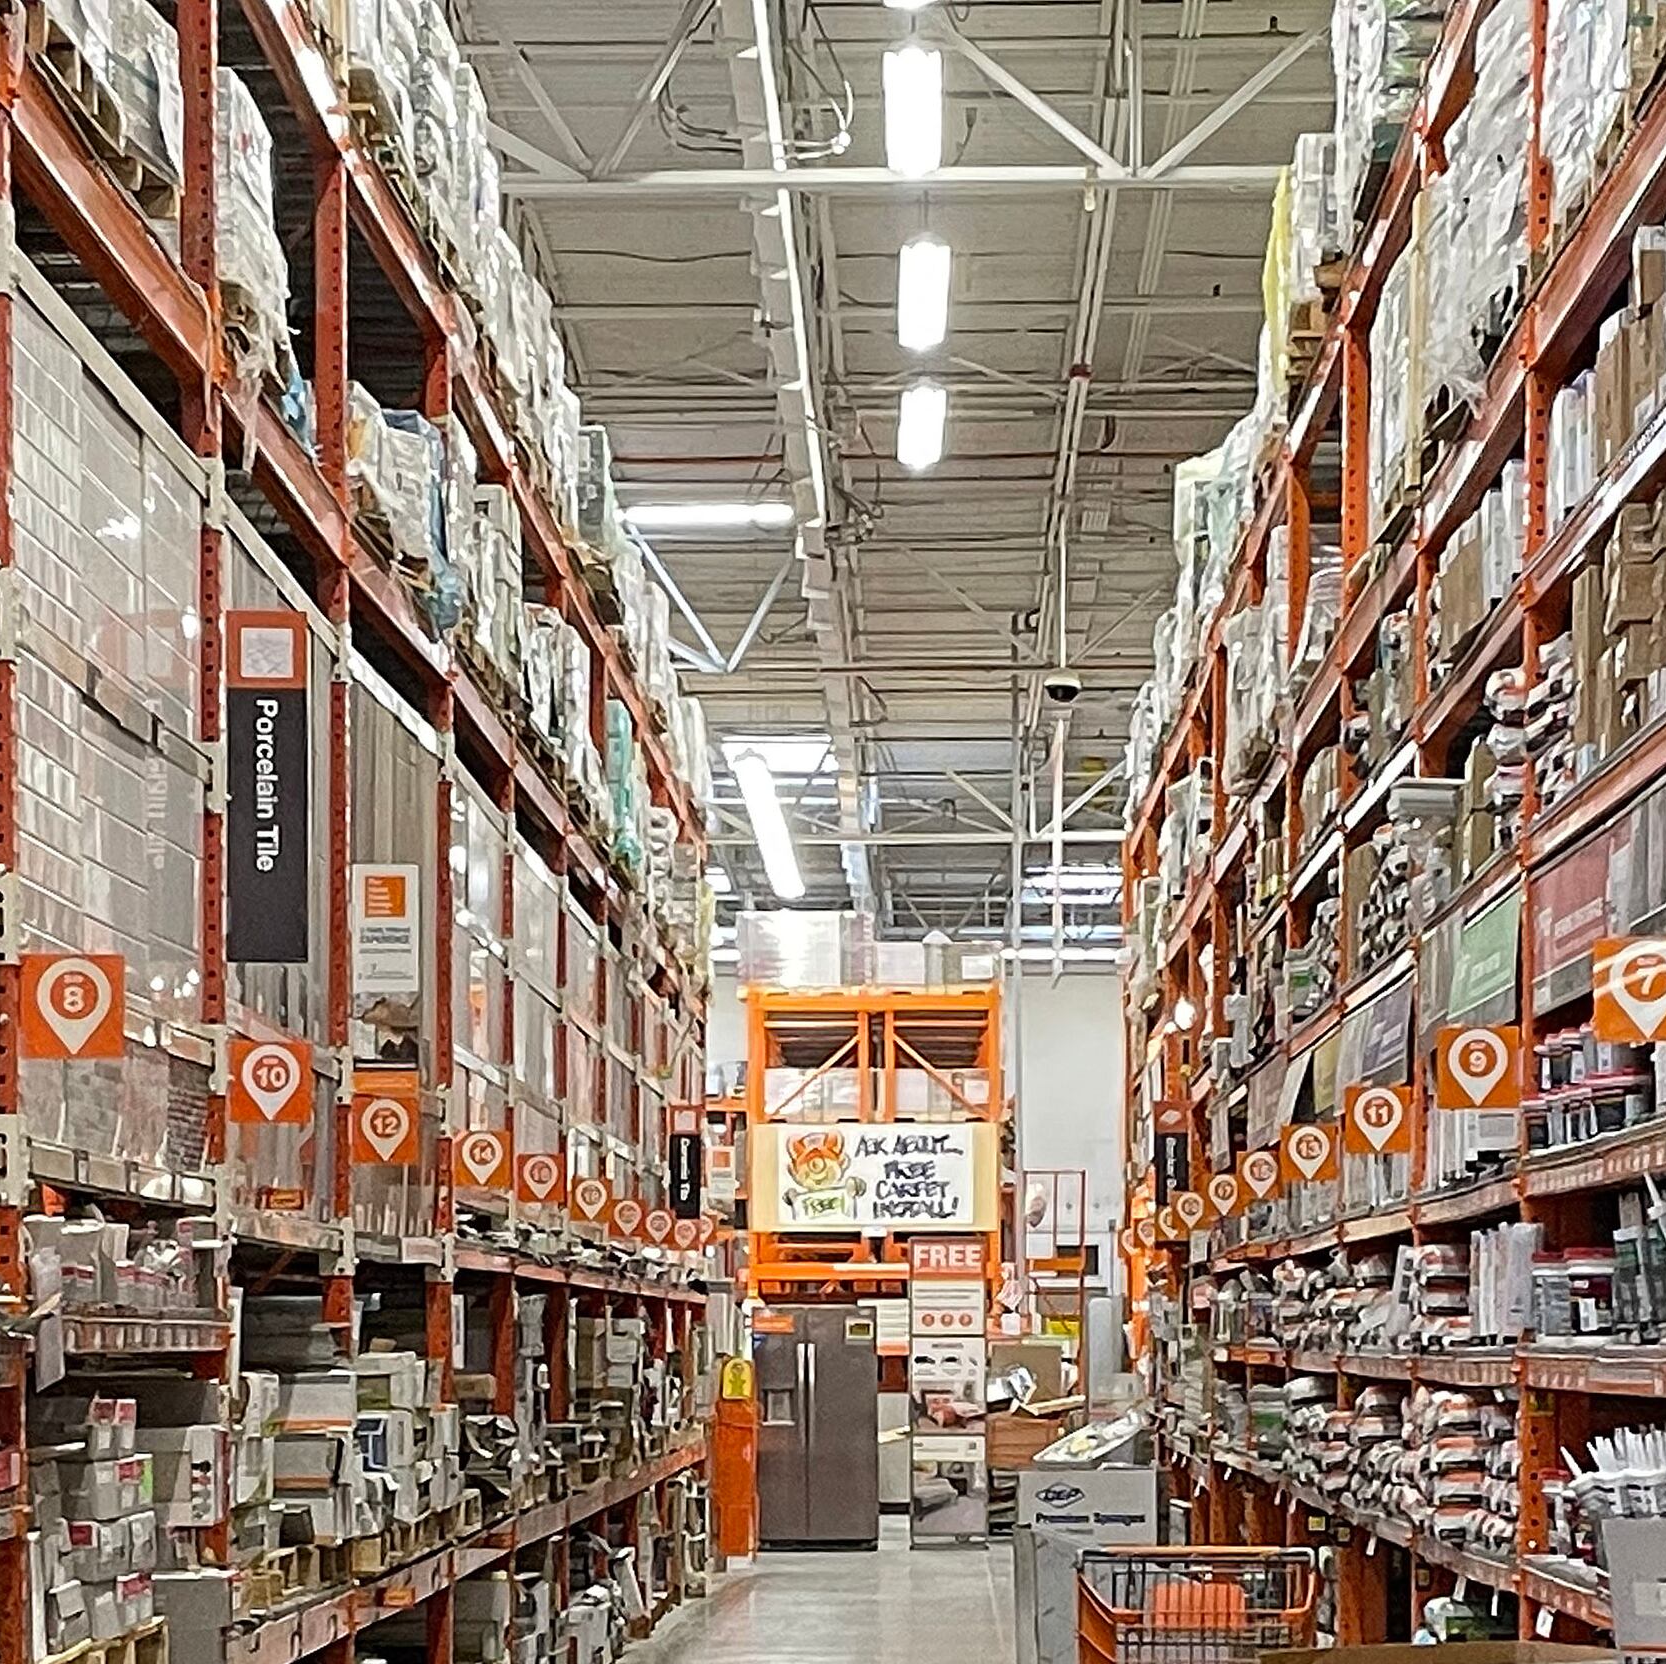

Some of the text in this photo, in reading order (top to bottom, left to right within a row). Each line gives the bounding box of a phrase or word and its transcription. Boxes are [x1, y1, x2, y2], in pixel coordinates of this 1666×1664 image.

[255, 698, 279, 872] Porcelain Tile
[1637, 965, 1662, 996] 7
[63, 985, 85, 1013] 8
[1469, 1050, 1487, 1073] 9
[256, 1066, 287, 1088] 10
[1367, 1105, 1389, 1124] 11
[373, 1116, 398, 1135] 12
[473, 1146, 493, 1163] 14
[1299, 1141, 1321, 1157] 13
[884, 1159, 936, 1180] FREE
[875, 1180, 950, 1200] CARPET
[912, 1244, 983, 1268] FREE
